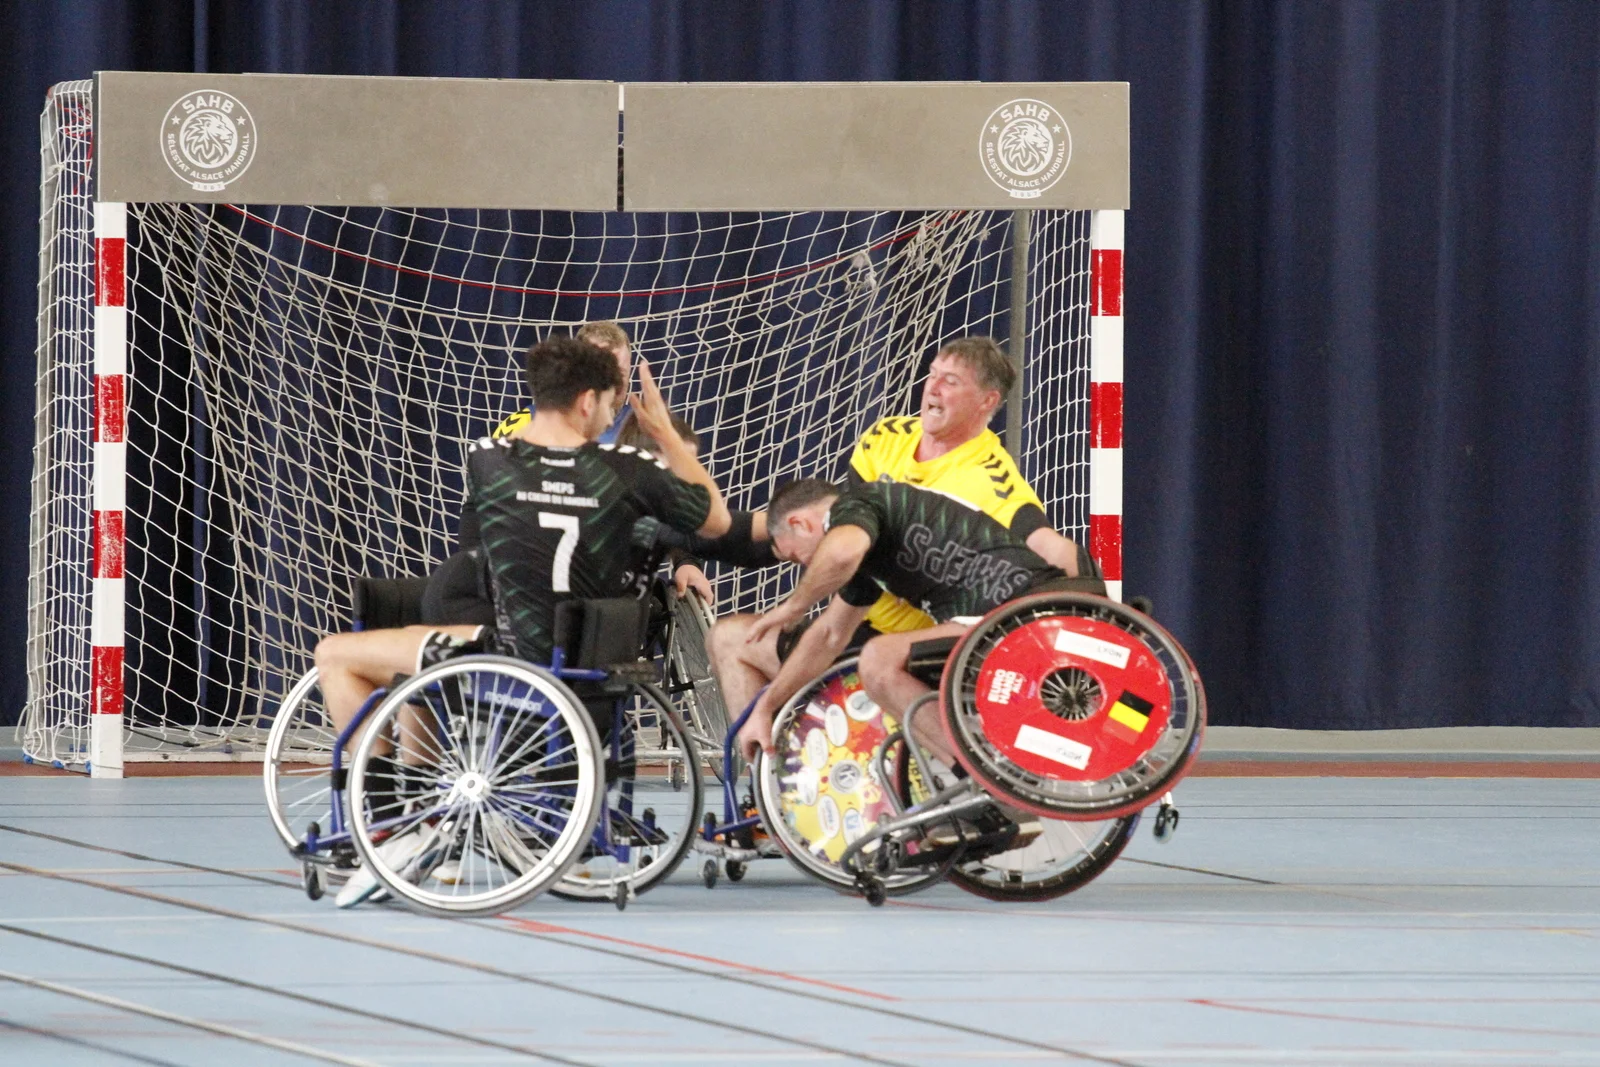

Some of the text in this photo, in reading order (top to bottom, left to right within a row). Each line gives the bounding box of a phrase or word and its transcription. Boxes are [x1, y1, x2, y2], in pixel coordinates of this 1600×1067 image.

[181, 95, 234, 114] SAHB
[1000, 104, 1050, 122] SAHB
[167, 133, 250, 180] SÉLESTAT ALSACE HANDBALL
[986, 140, 1065, 188] SÉLESTAT ALSACE HANDBALL
[541, 480, 575, 495] SMEPS
[538, 511, 579, 592] 7
[897, 523, 1033, 606] SMEPS
[484, 691, 542, 712] motivation
